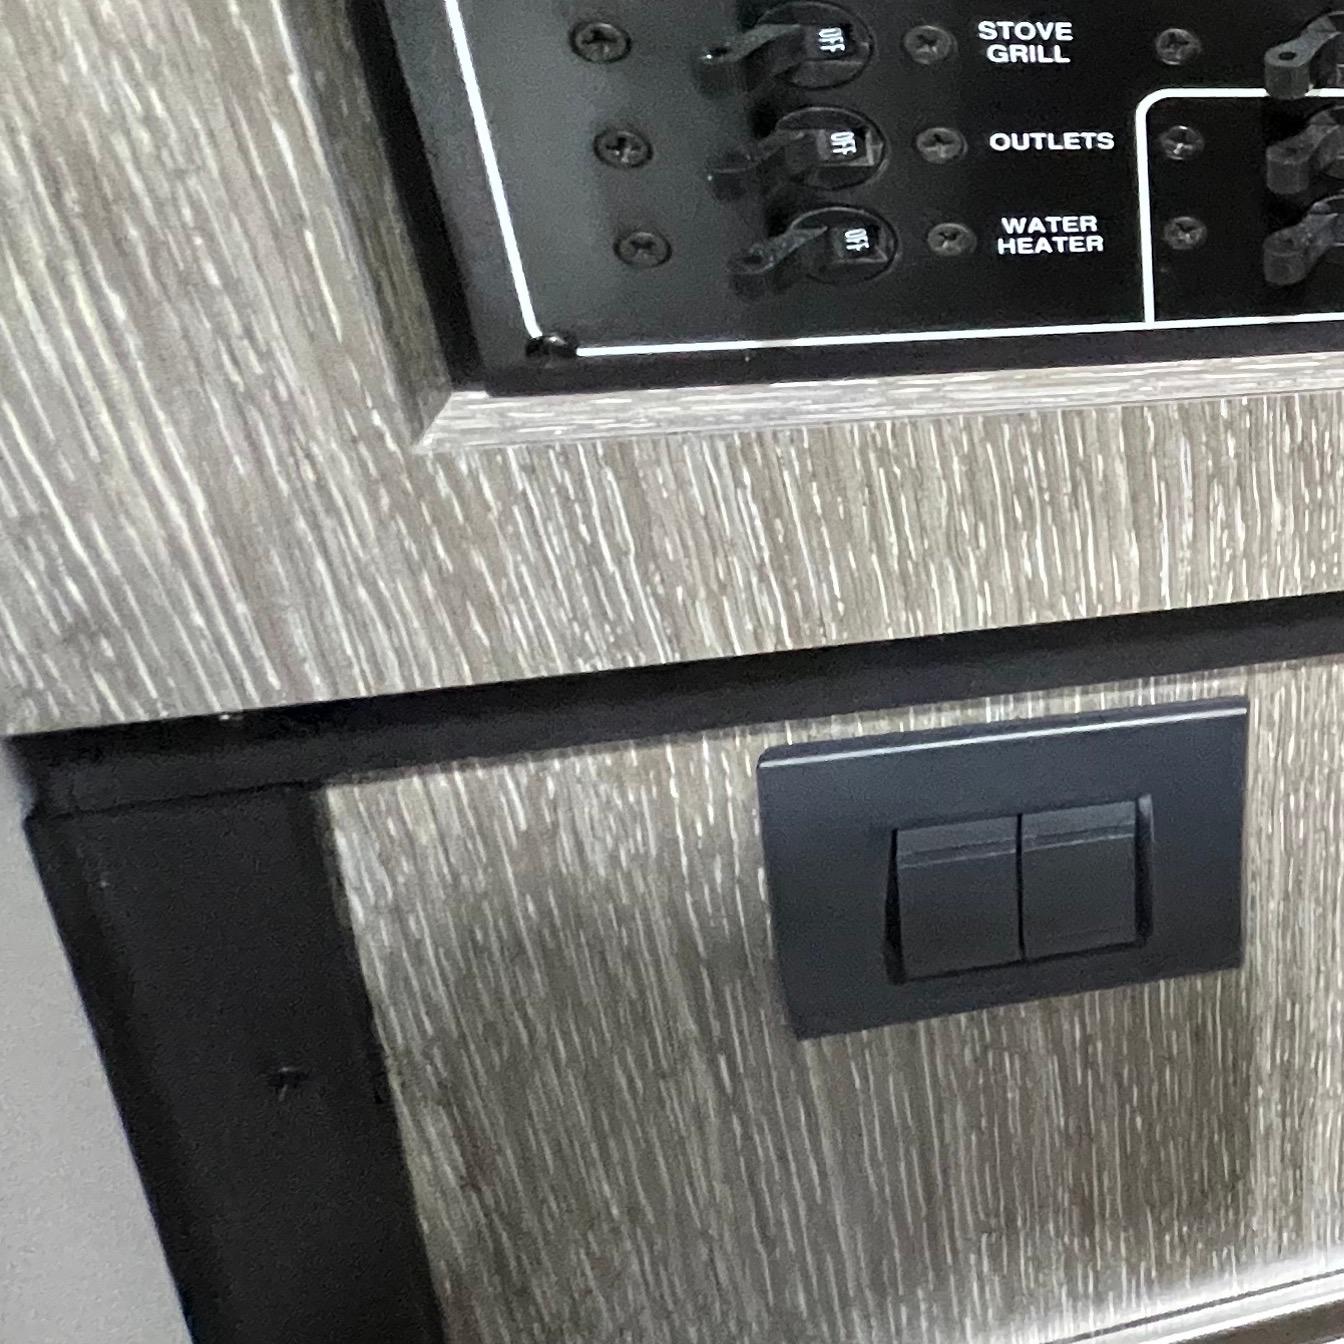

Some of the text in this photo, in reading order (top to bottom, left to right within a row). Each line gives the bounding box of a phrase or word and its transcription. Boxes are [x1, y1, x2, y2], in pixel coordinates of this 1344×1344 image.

[819, 27, 845, 53] OFF
[977, 21, 1073, 43] STOVE
[986, 44, 1070, 64] GRILL
[830, 131, 857, 155] OFF
[989, 131, 1114, 152] OUTLETS
[1001, 216, 1097, 235] WATER
[844, 228, 870, 252] OFF
[998, 236, 1103, 254] HEATER
